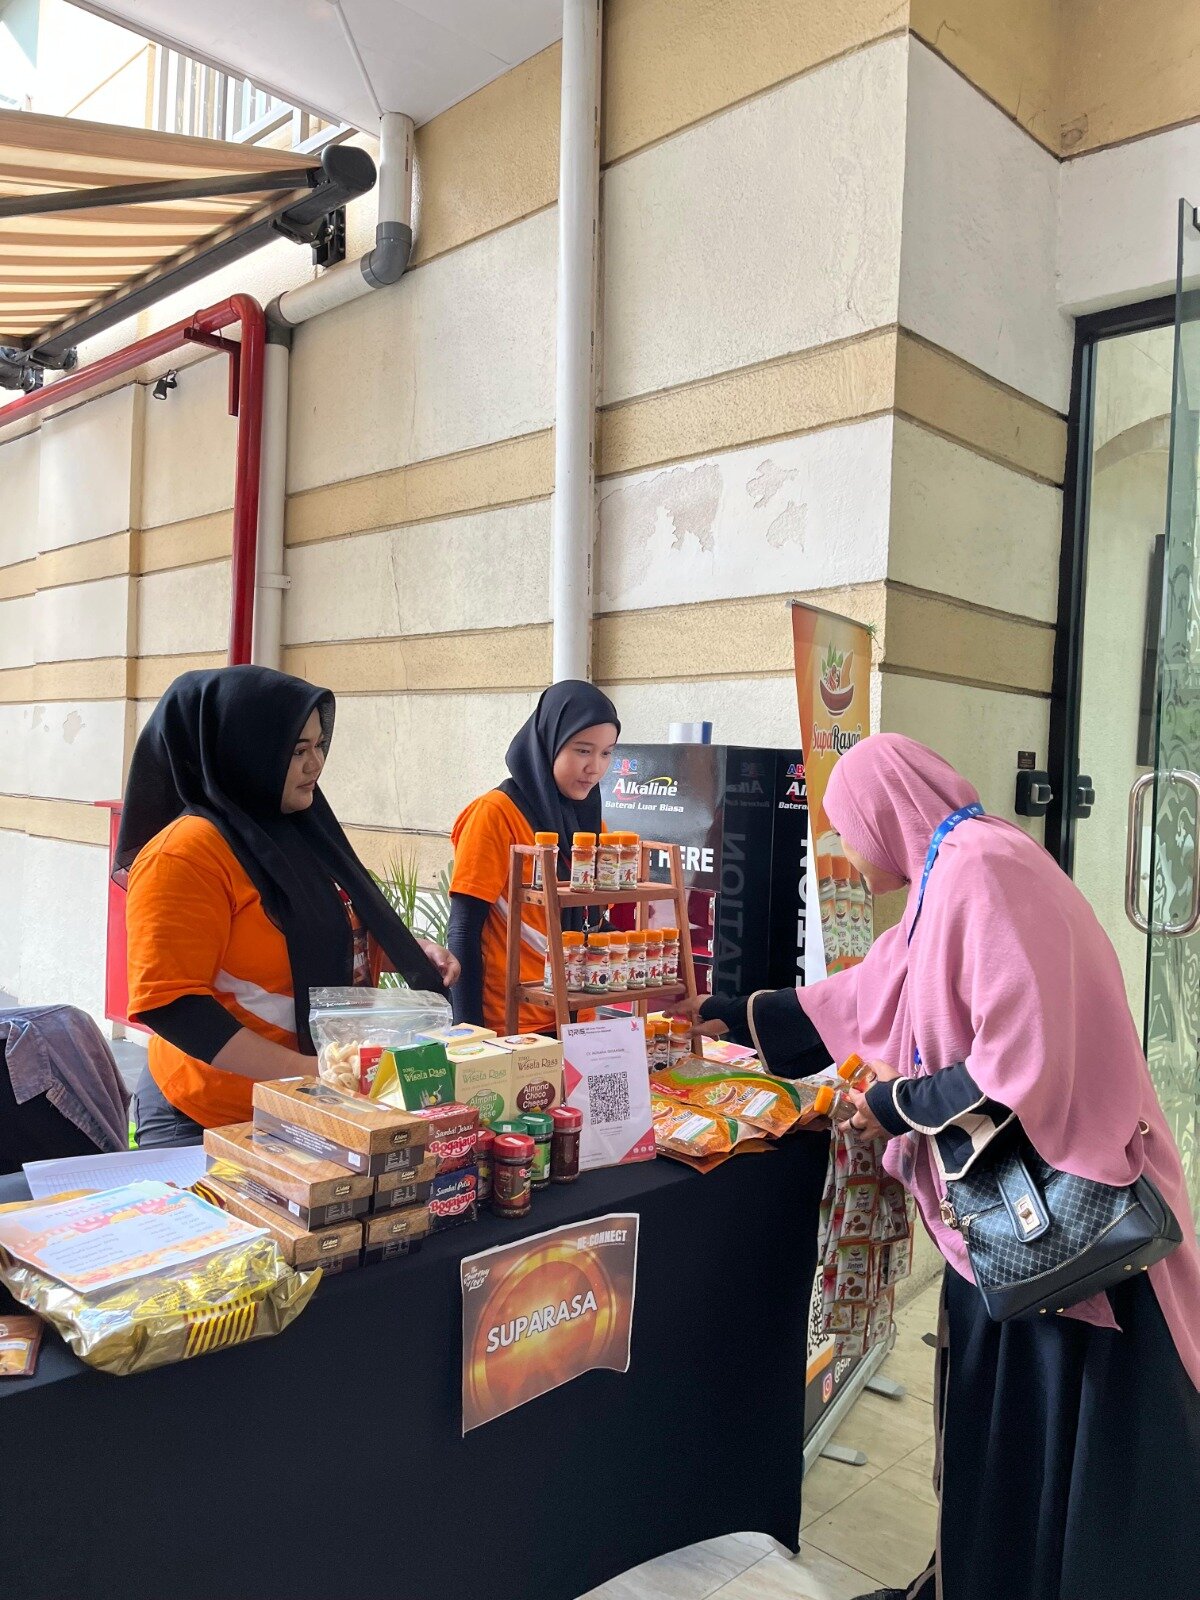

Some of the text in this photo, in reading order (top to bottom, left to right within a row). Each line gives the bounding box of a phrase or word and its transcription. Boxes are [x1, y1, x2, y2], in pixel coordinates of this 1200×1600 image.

[613, 758, 638, 772] ABC
[786, 763, 805, 775] AB
[611, 777, 678, 797] Alkaline
[604, 800, 685, 813] Baterai Luar Biasa
[778, 801, 809, 811] Batera
[541, 1058, 558, 1068] Rasa
[523, 1083, 549, 1094] Almond
[469, 1093, 498, 1105] Almond
[525, 1092, 547, 1101] Choco
[522, 1098, 549, 1109] Cheese
[434, 1126, 457, 1139] Sambal
[429, 1134, 477, 1156] Bogajaya
[435, 1182, 458, 1197] Sambal
[429, 1190, 476, 1215] Bogajaya
[846, 1262, 864, 1270] Jinten
[485, 1289, 598, 1354] SUPARASA
